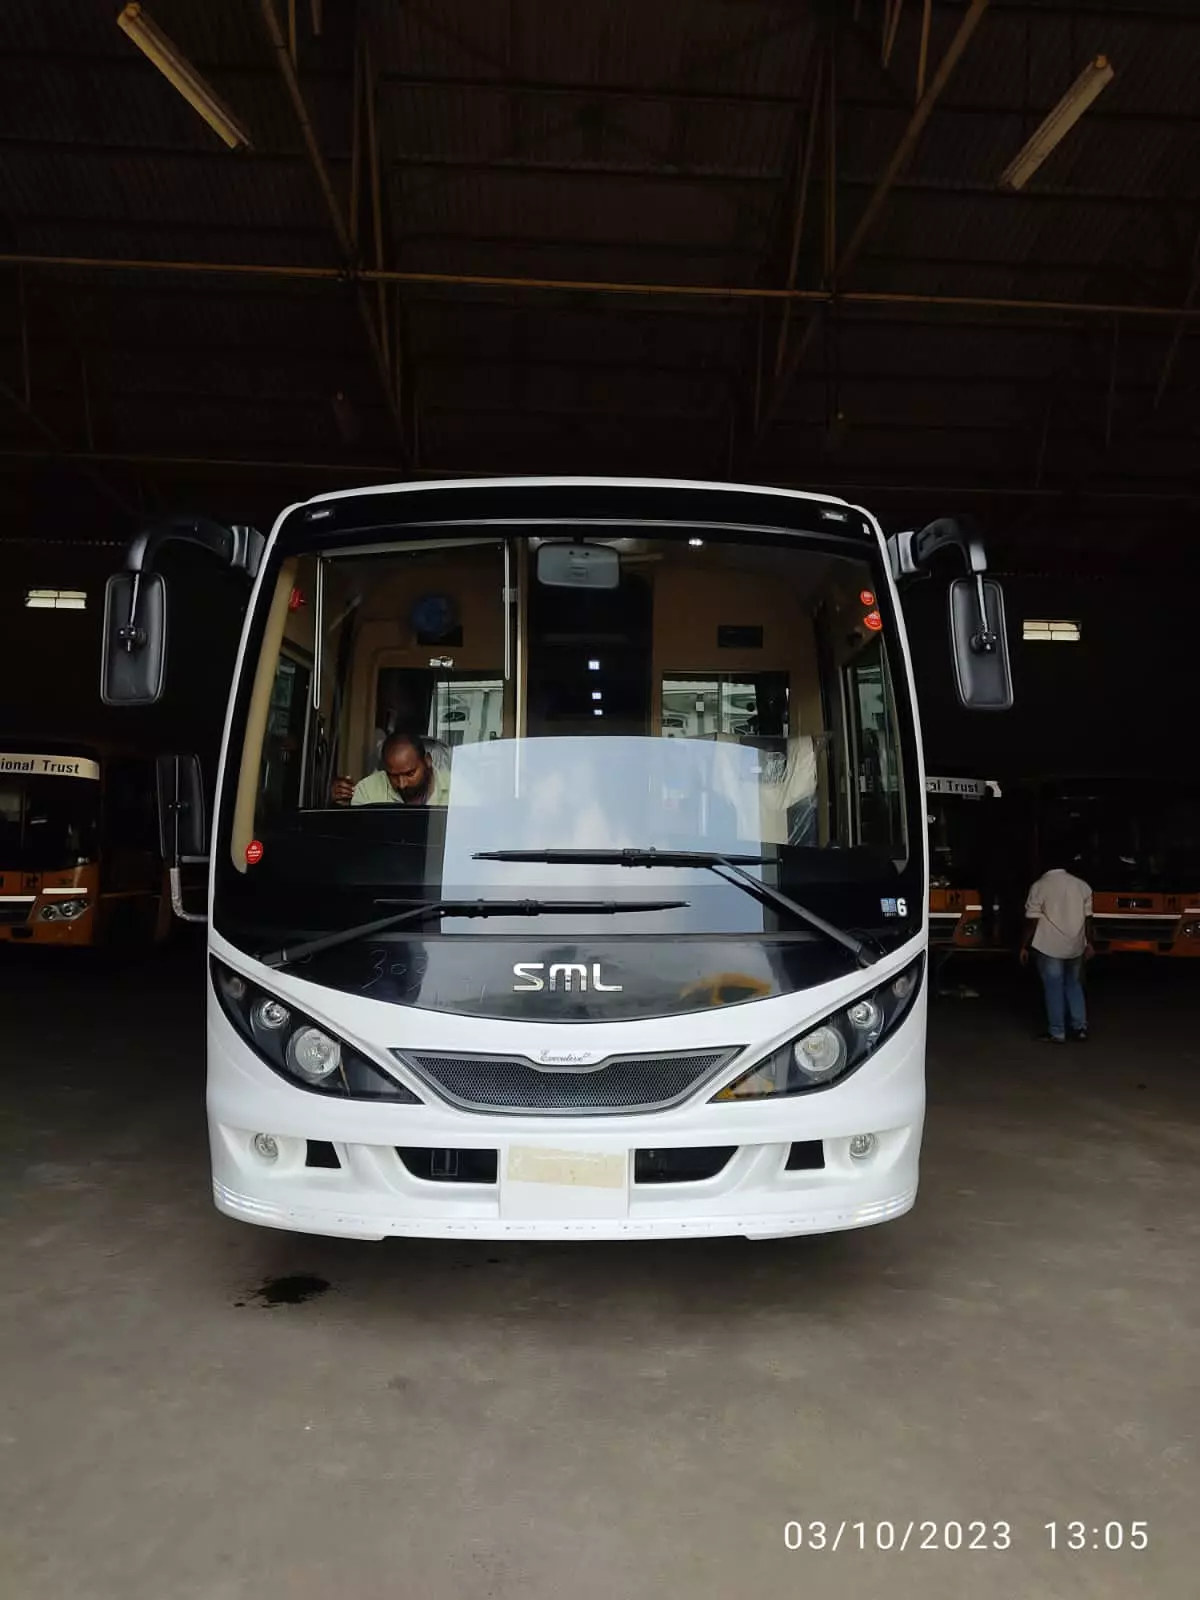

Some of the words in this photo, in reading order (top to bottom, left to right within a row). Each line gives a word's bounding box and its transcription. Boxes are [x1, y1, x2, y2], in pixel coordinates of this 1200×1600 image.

[1, 758, 34, 771] ional
[42, 759, 80, 774] Trust
[926, 780, 941, 792] al
[946, 780, 978, 793] Trust
[512, 963, 623, 991] SML
